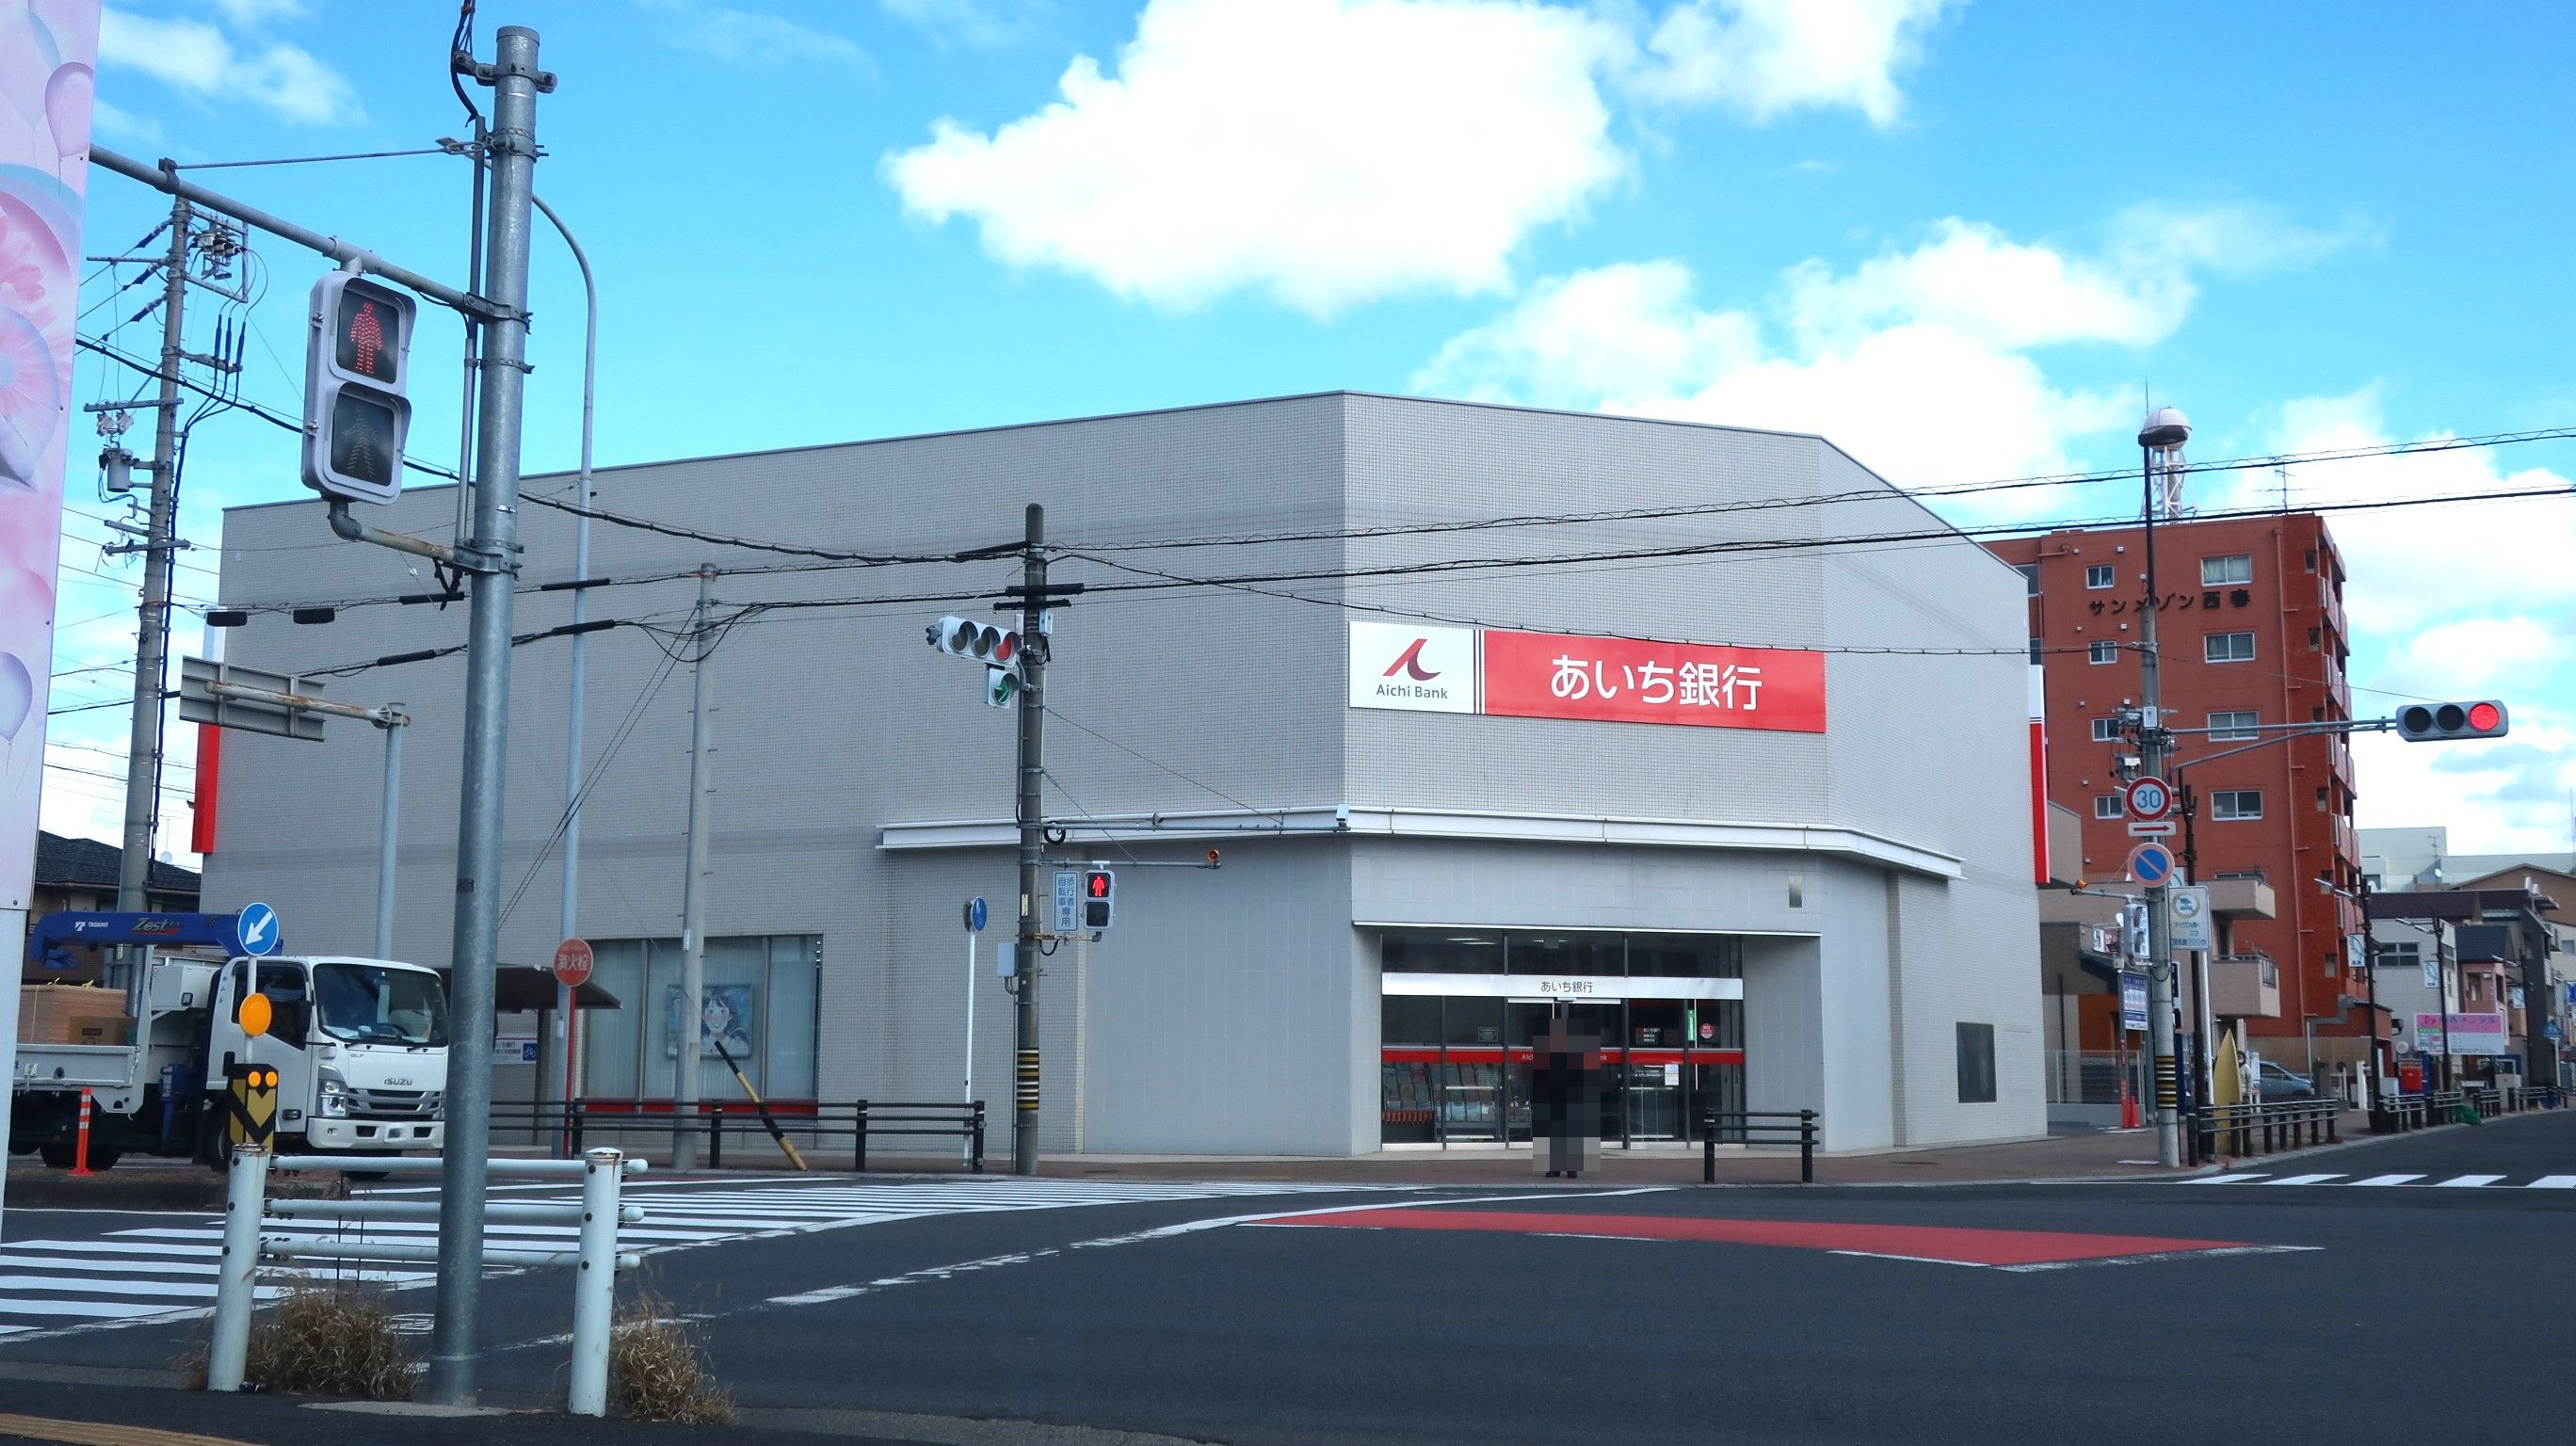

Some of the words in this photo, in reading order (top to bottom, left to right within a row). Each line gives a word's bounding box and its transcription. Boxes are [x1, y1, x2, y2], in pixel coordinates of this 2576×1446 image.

[1551, 654, 1763, 711] あいち銀行
[1376, 683, 1410, 697] Aichi
[1414, 685, 1448, 699] Bank
[2136, 789, 2162, 810] 30
[557, 954, 588, 971] 消火栓
[1540, 981, 1593, 993] あいち銀行
[383, 1077, 413, 1085] ISUZU
